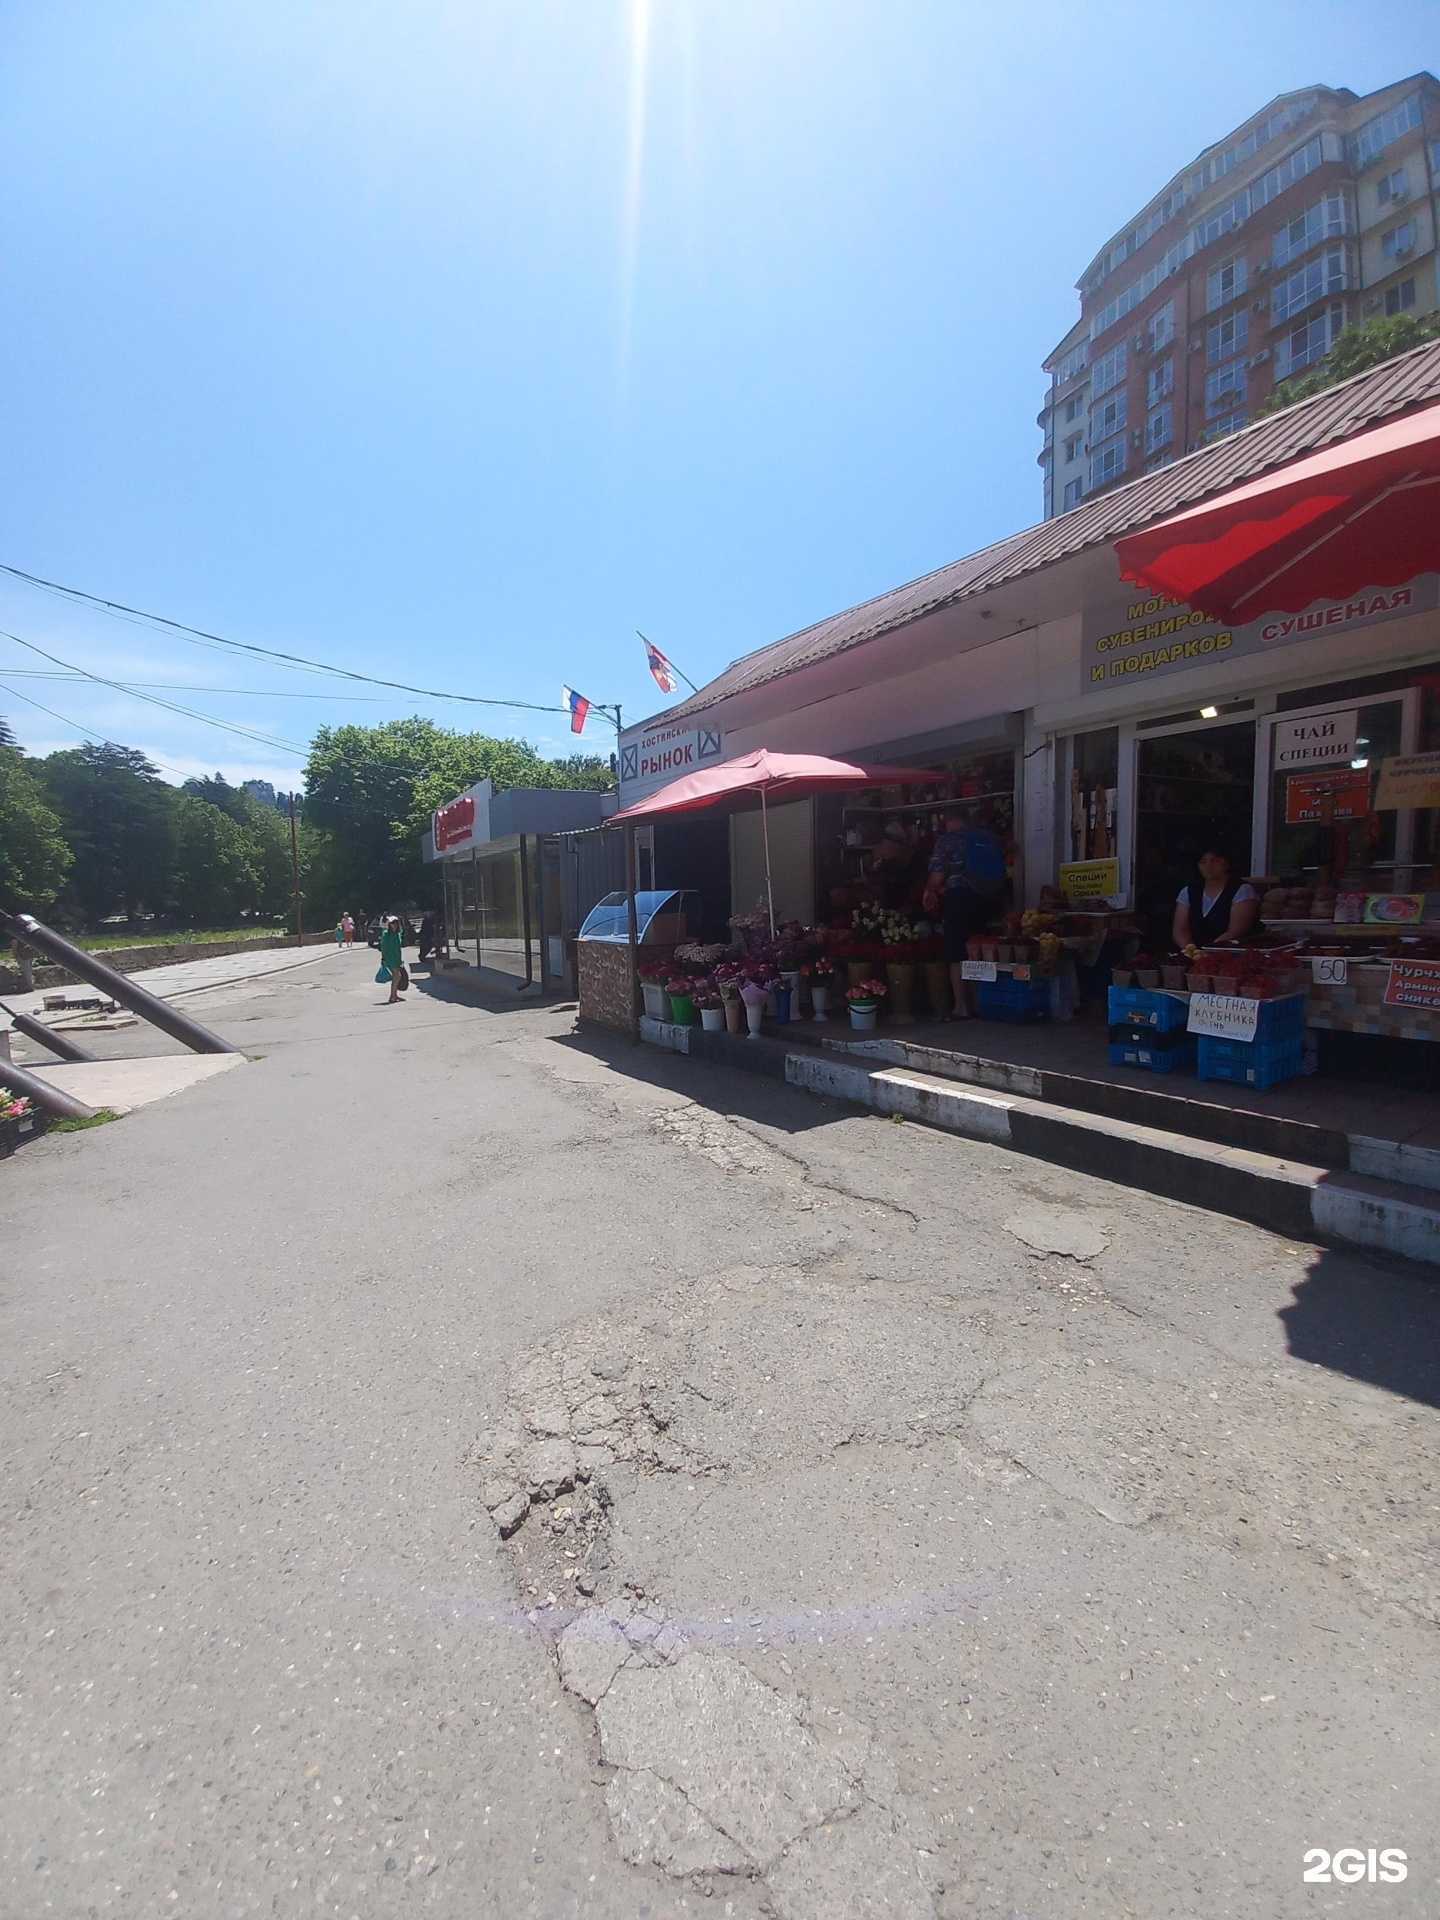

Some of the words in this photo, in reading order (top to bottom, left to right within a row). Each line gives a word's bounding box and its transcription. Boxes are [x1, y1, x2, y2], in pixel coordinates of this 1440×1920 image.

[1261, 588, 1412, 641] СУШЕНАЯ
[1096, 609, 1222, 651] СУВЕНИРО
[1091, 663, 1105, 681] И
[1110, 631, 1233, 677] ПОДАРКОВ
[1293, 720, 1337, 740] ЧАЙ
[641, 743, 693, 776] РЫНОК
[1279, 743, 1349, 763] СПЕЦИИ
[1319, 958, 1346, 982] 50
[1194, 1007, 1256, 1026] КЛУБНИКА
